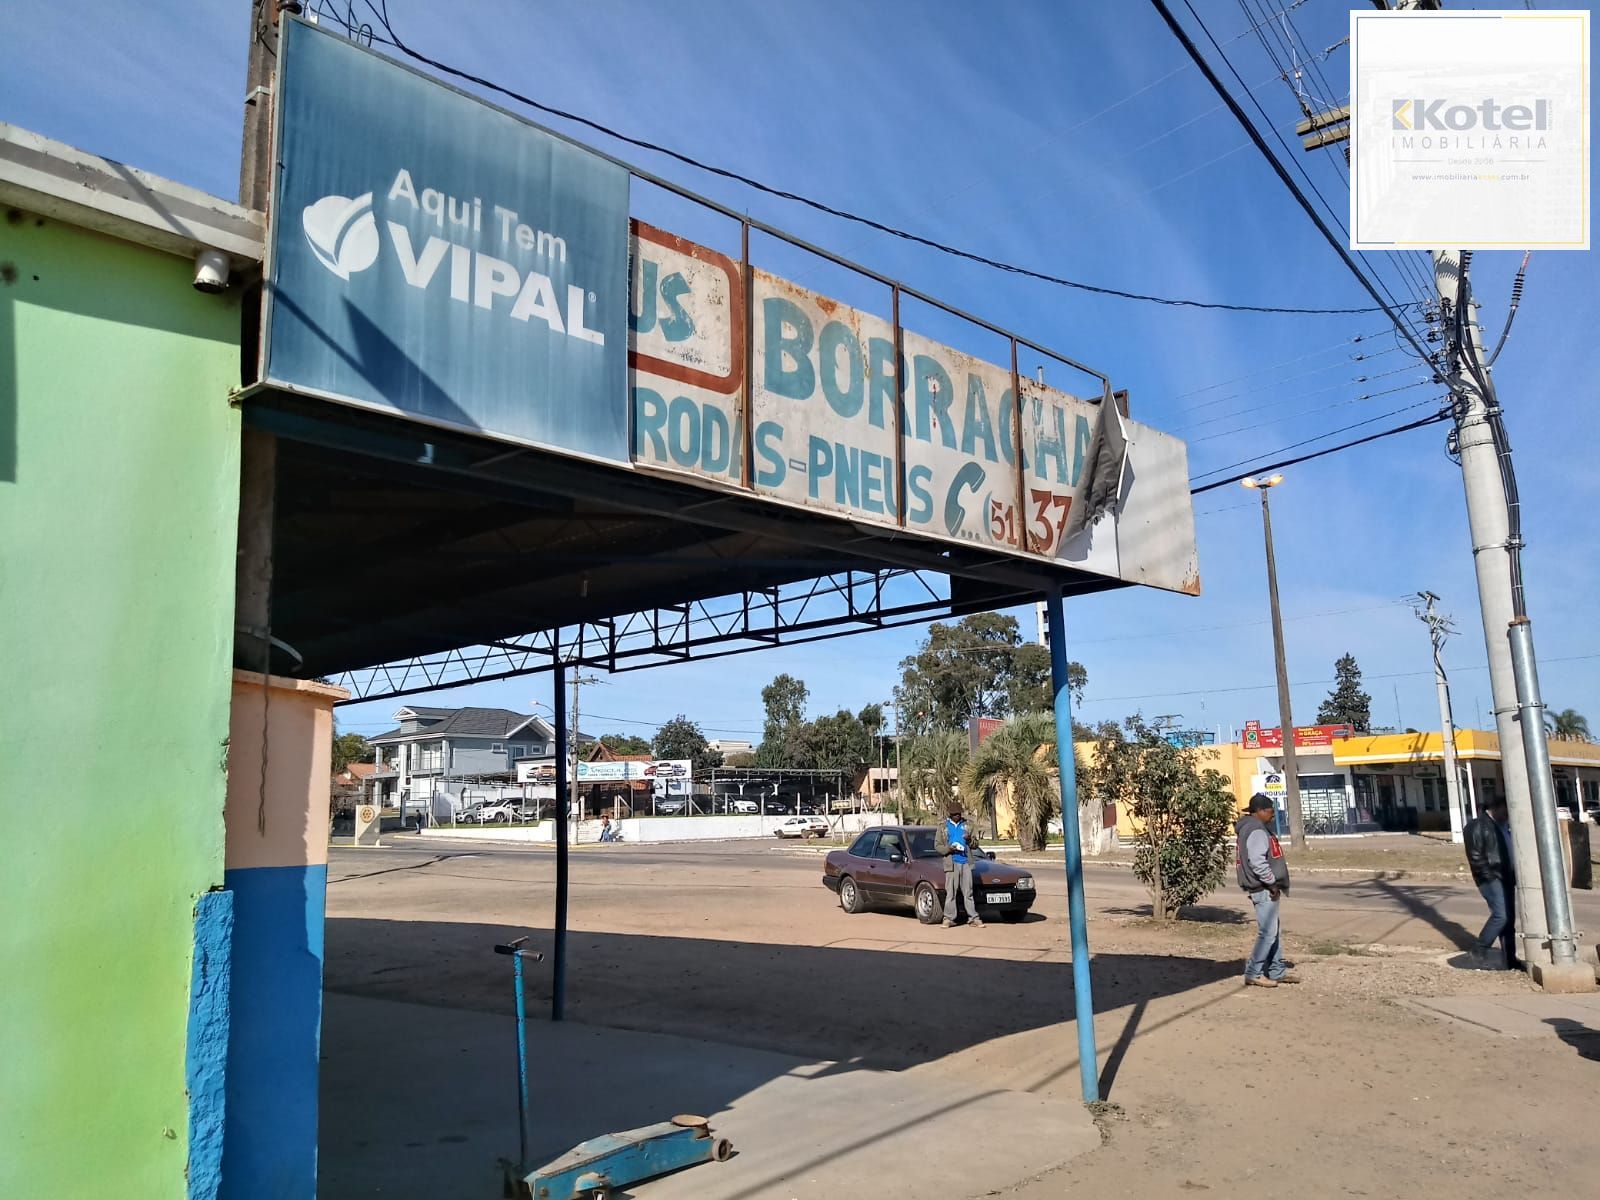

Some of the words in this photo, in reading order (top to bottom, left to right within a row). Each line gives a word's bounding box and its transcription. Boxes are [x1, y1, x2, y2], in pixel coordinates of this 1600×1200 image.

[387, 167, 482, 233] Aqui
[494, 204, 568, 264] Tem
[386, 219, 605, 346] VIPAL
